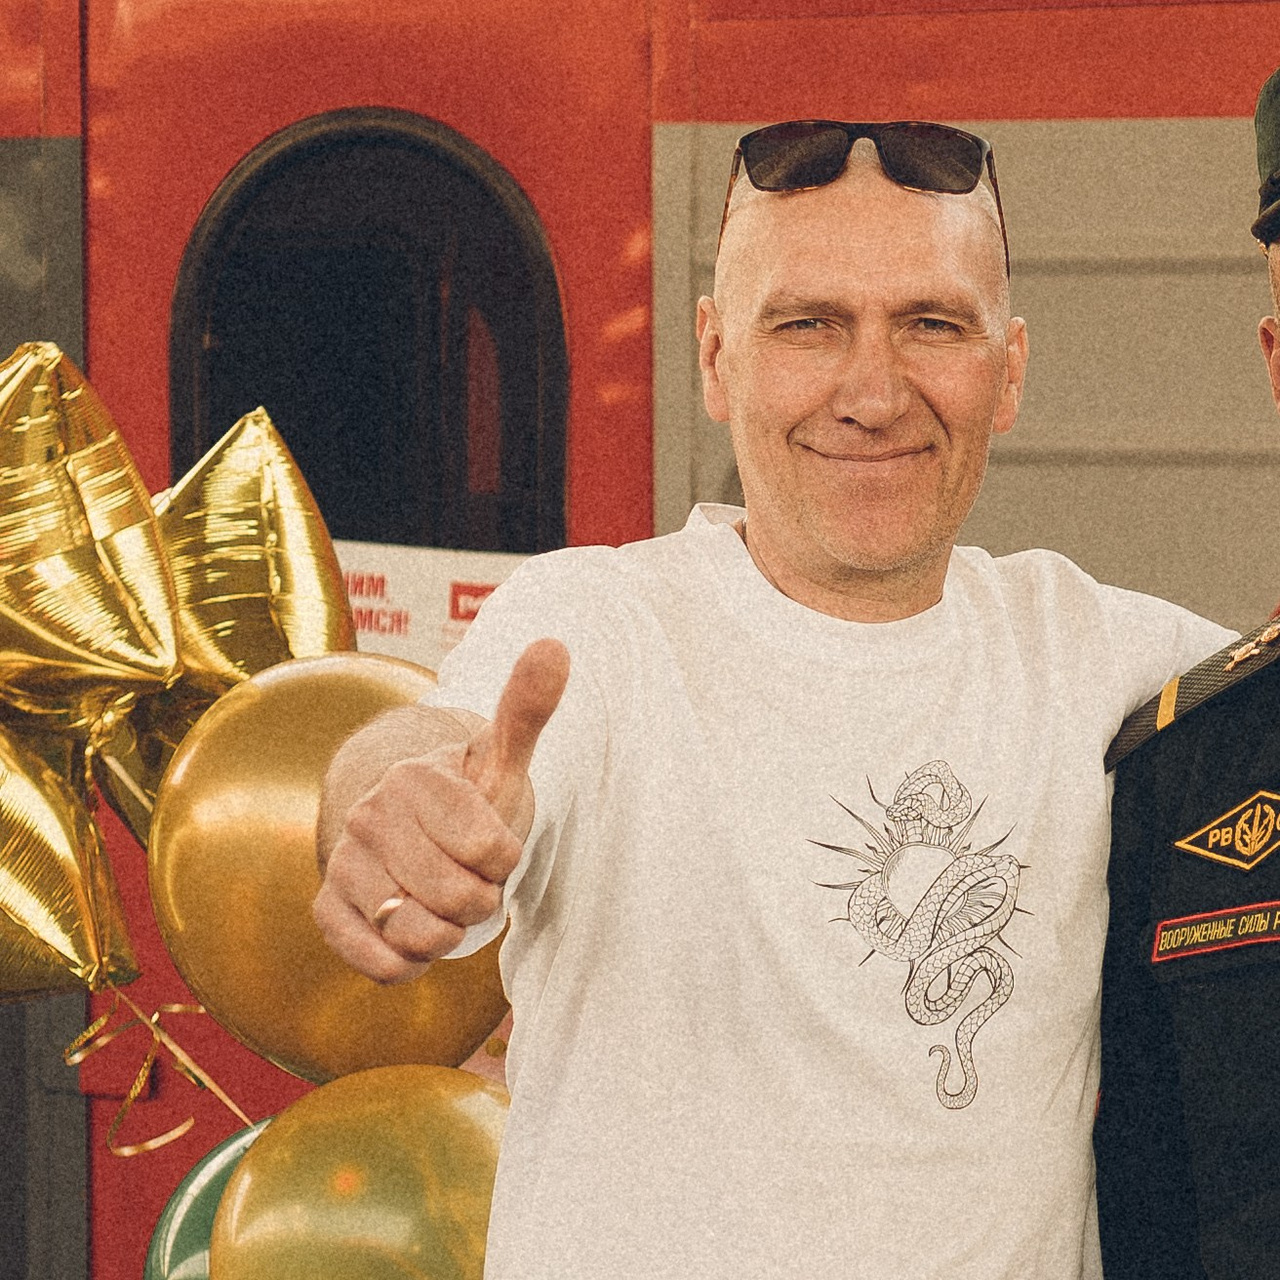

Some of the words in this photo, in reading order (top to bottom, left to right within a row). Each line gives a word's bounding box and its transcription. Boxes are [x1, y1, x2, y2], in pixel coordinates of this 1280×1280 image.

[1208, 827, 1232, 849] РВ
[1159, 919, 1236, 951] ВООРУЖЕННЫЕ
[1238, 913, 1269, 935] СИЛЫ
